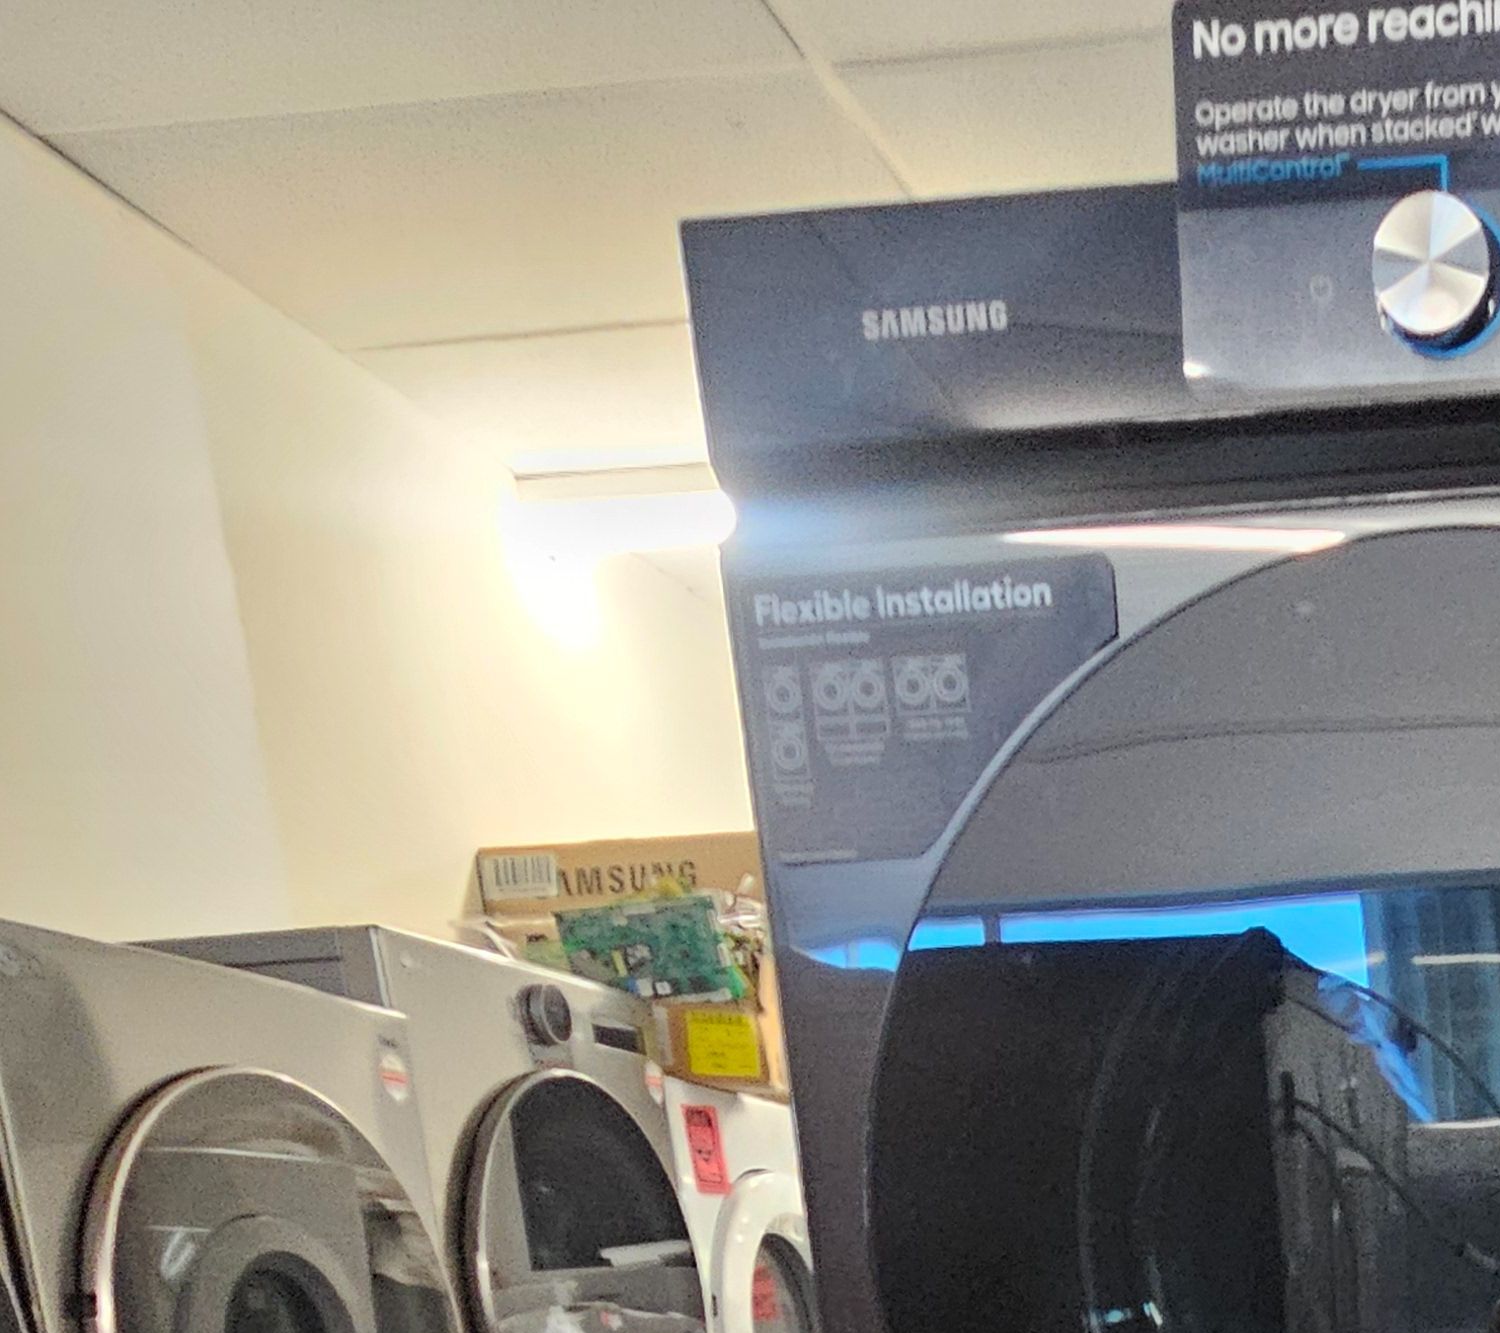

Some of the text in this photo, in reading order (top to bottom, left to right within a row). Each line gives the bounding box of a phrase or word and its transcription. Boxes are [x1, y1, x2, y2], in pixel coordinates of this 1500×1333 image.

[1192, 18, 1247, 60] No
[1254, 12, 1360, 55] more
[1194, 95, 1299, 131] Operate
[1303, 91, 1346, 119] the
[1350, 86, 1416, 118] dryer
[1424, 81, 1486, 109] from
[1195, 126, 1290, 157] washer
[1296, 120, 1367, 150] when
[861, 299, 1009, 342] SAMSUNG
[754, 574, 1054, 627] Flexible Installation
